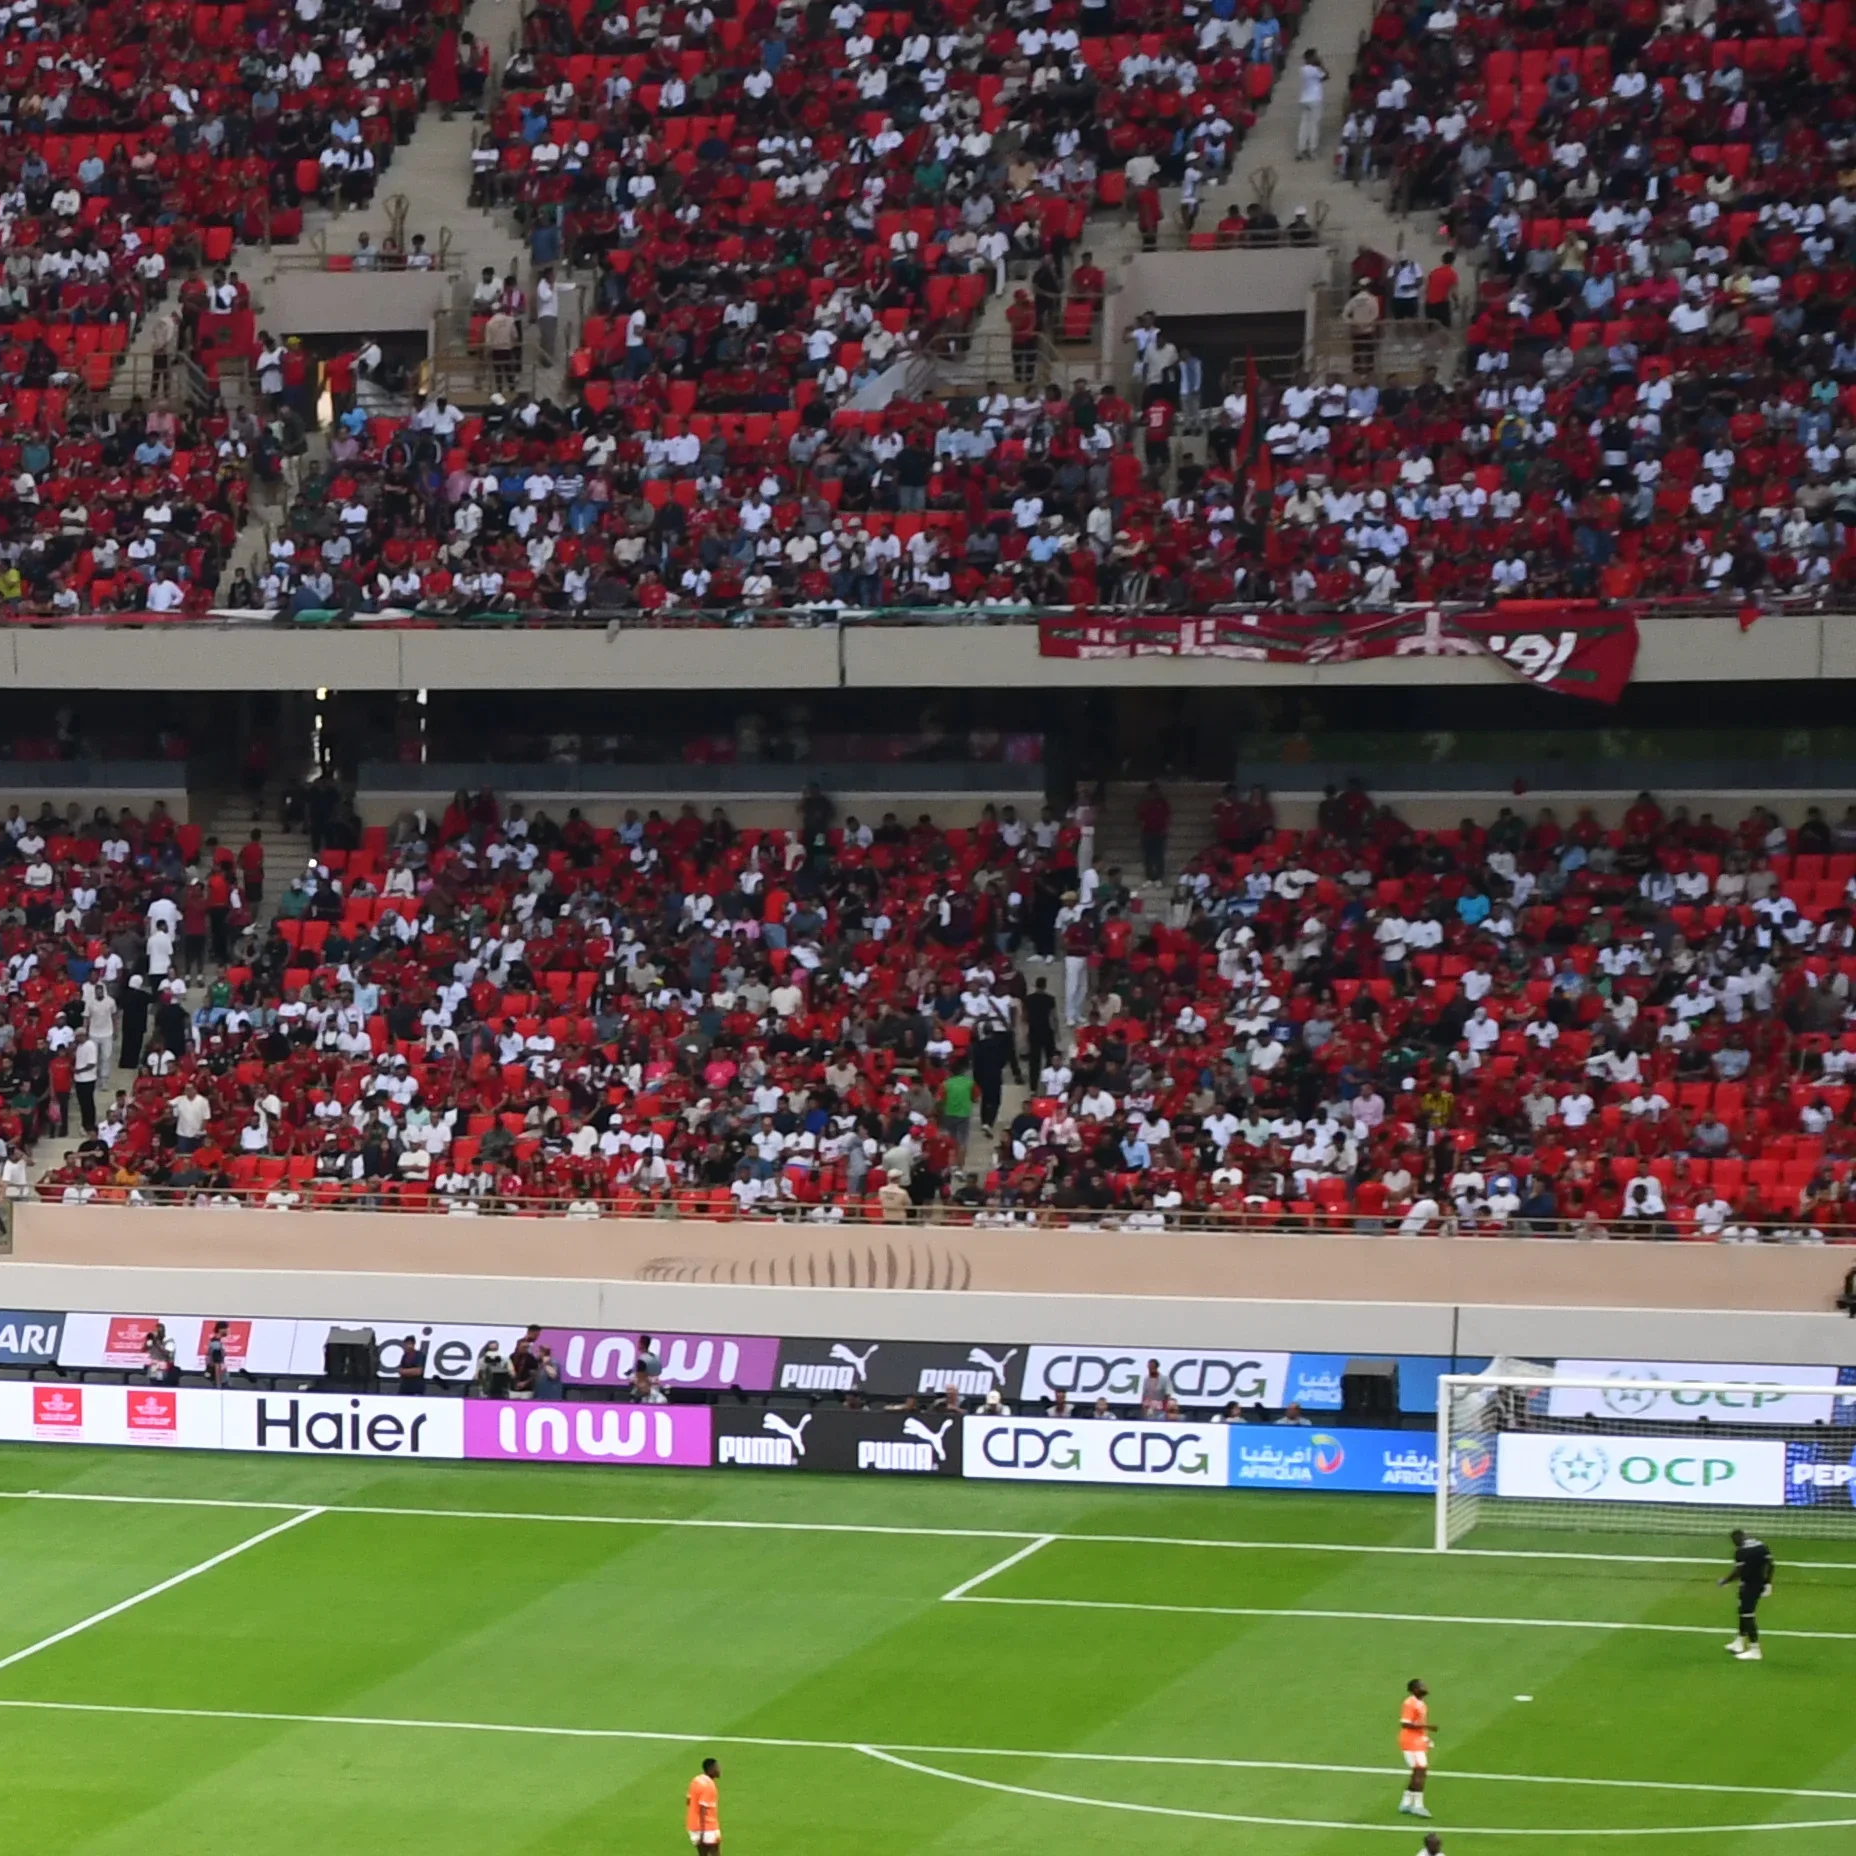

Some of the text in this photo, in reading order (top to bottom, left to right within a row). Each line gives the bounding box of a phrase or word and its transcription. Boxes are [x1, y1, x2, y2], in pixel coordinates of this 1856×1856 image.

[780, 1364, 856, 1390] PUMA
[918, 1369, 993, 1395] PUMA
[1043, 1355, 1140, 1394] CDG
[1169, 1358, 1267, 1398] CDG
[256, 1398, 427, 1453] Haier
[499, 1406, 673, 1458] inwi
[718, 1436, 795, 1465] PUMA
[858, 1441, 935, 1470] PUMA
[982, 1427, 1080, 1470] CDG
[1109, 1431, 1209, 1474] CDG
[1619, 1455, 1736, 1486] OCP
